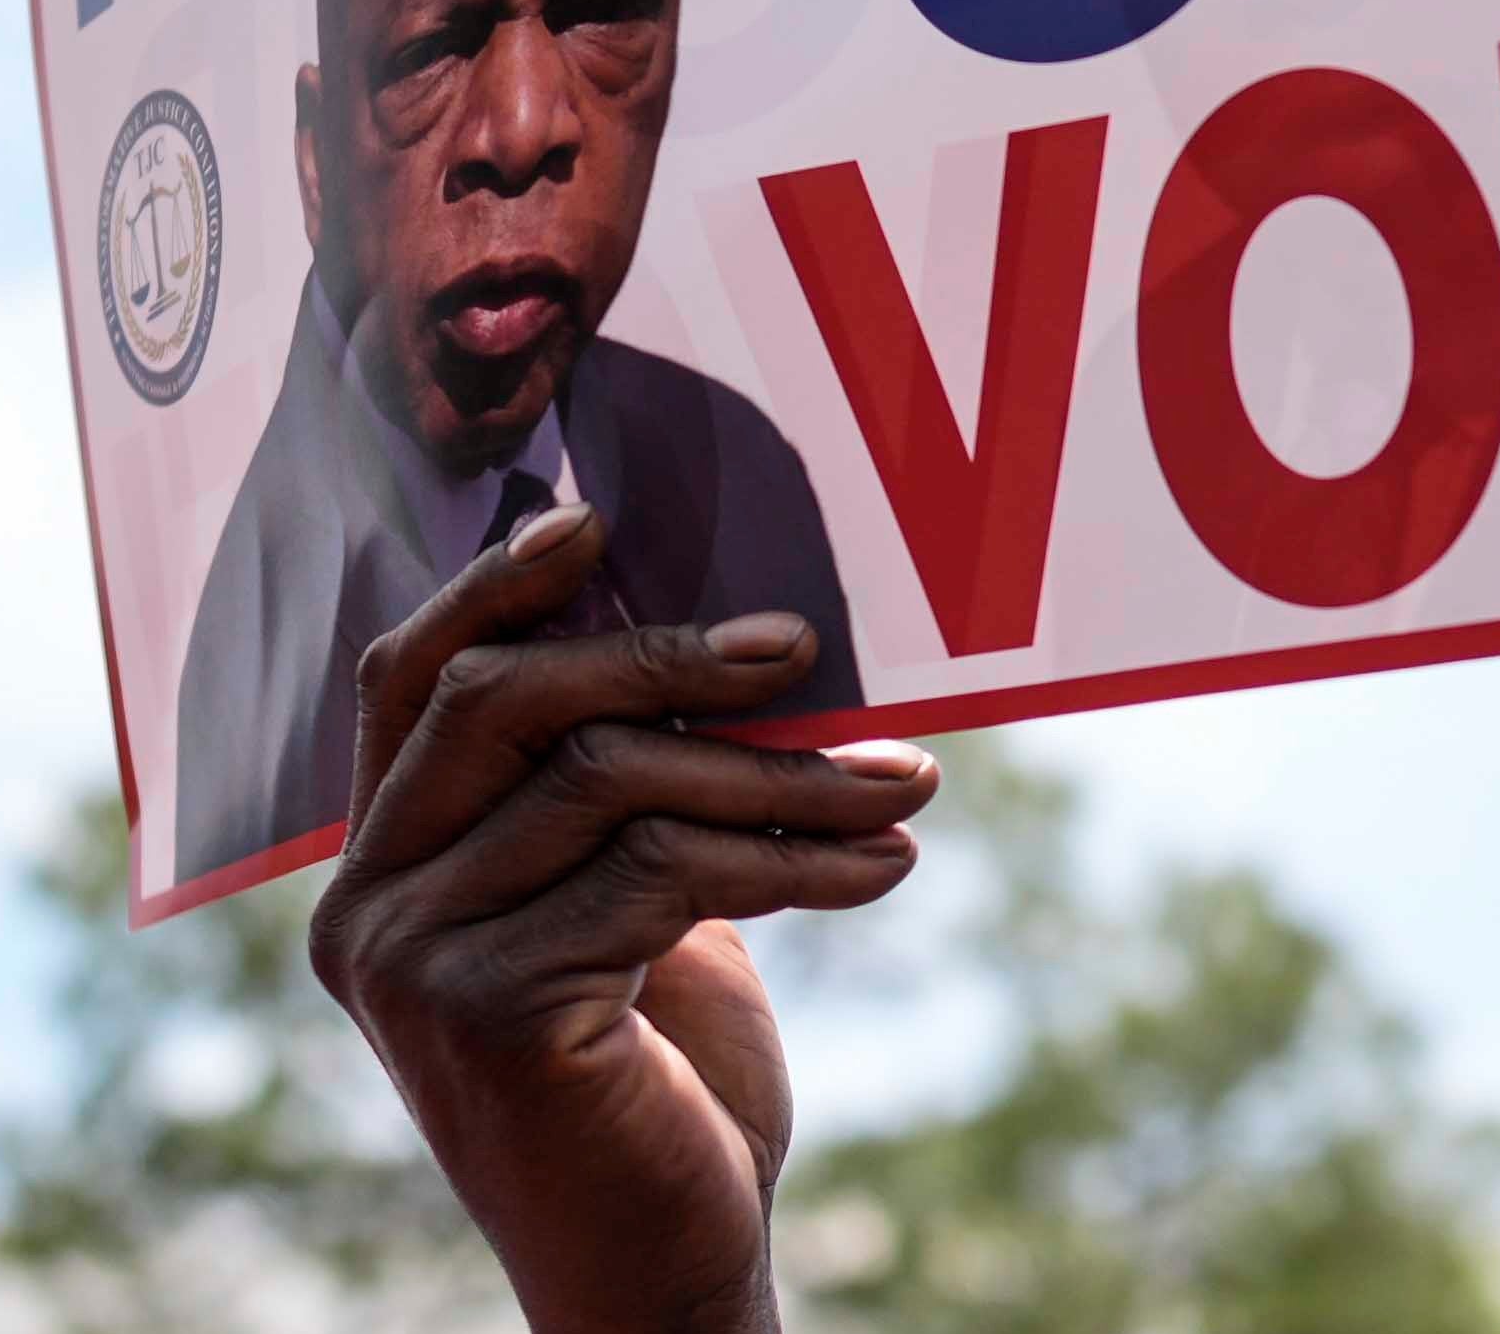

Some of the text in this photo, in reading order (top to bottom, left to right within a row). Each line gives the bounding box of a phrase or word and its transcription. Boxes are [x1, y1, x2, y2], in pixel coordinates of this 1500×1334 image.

[132, 136, 166, 180] TJC
[144, 97, 191, 129] JUSTICE
[190, 121, 220, 258] COALITION
